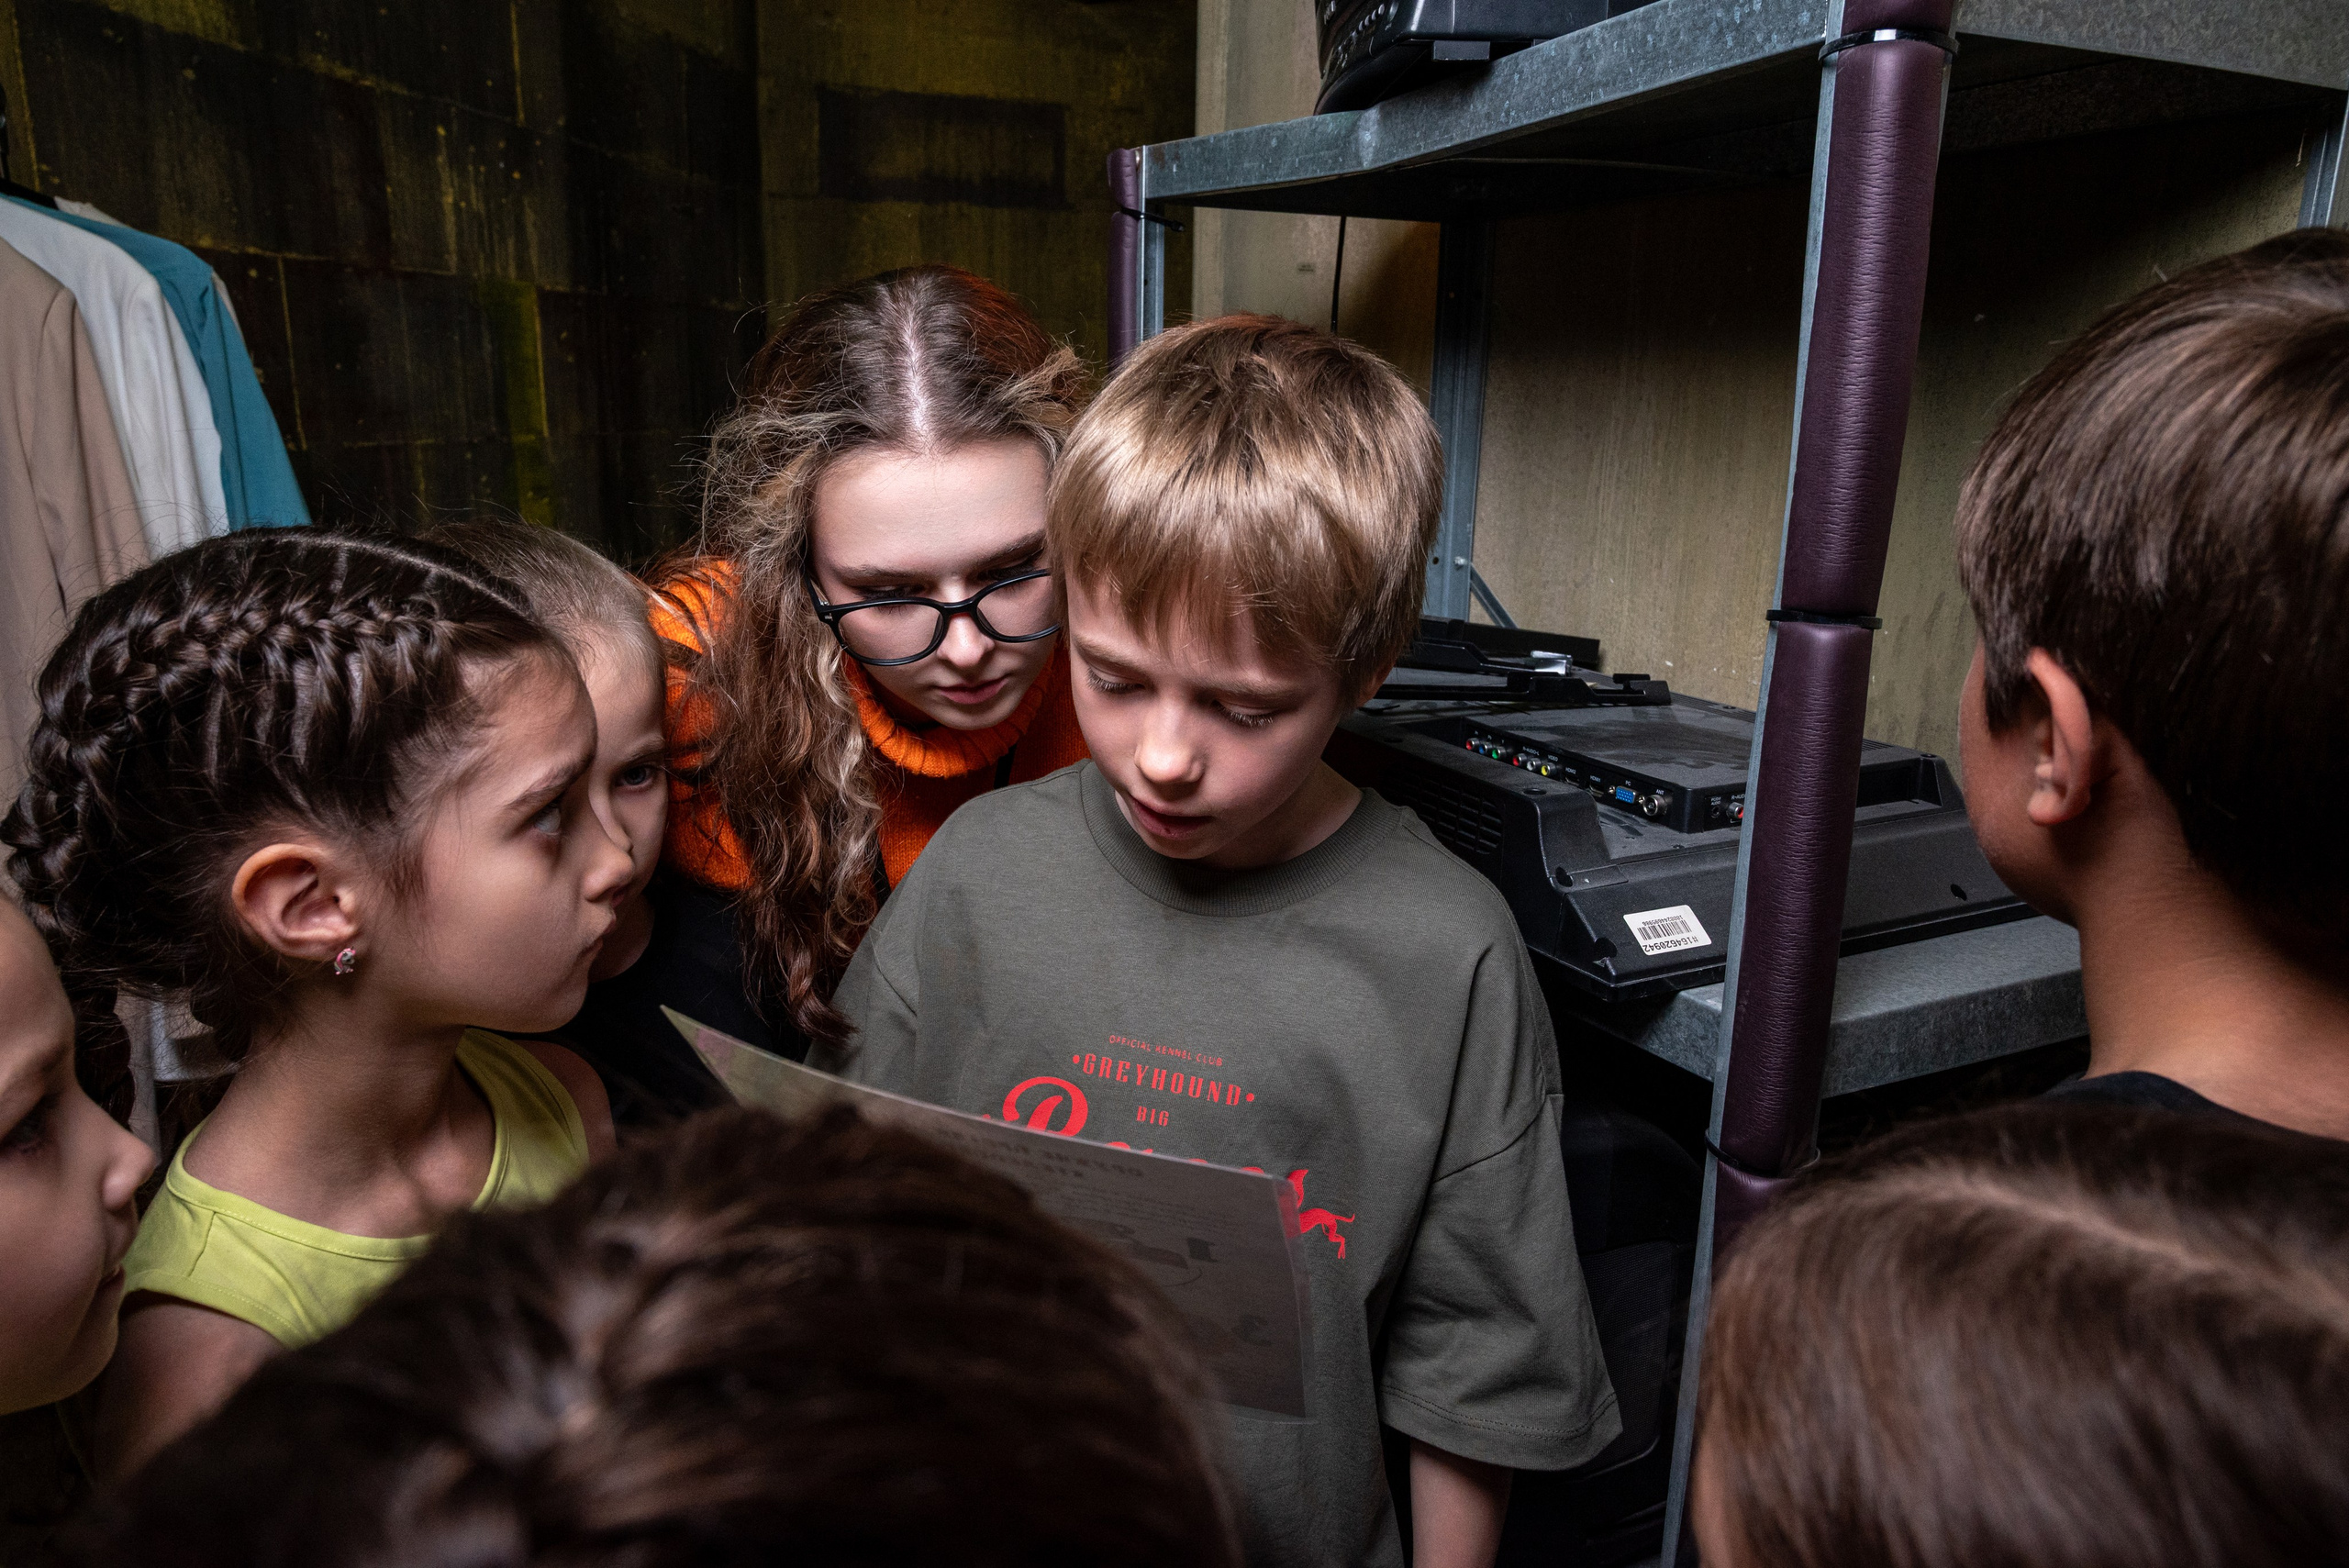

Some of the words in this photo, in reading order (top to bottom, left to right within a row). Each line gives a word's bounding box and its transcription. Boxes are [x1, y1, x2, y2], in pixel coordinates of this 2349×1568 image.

[1642, 935, 1698, 952] #164620942
[1108, 1034, 1152, 1052] OFFICIAL
[1154, 1045, 1193, 1062] KENNEL
[1196, 1052, 1223, 1067] CLUB
[1082, 1053, 1241, 1106] GREYHOUND
[1136, 1106, 1170, 1127] BIG
